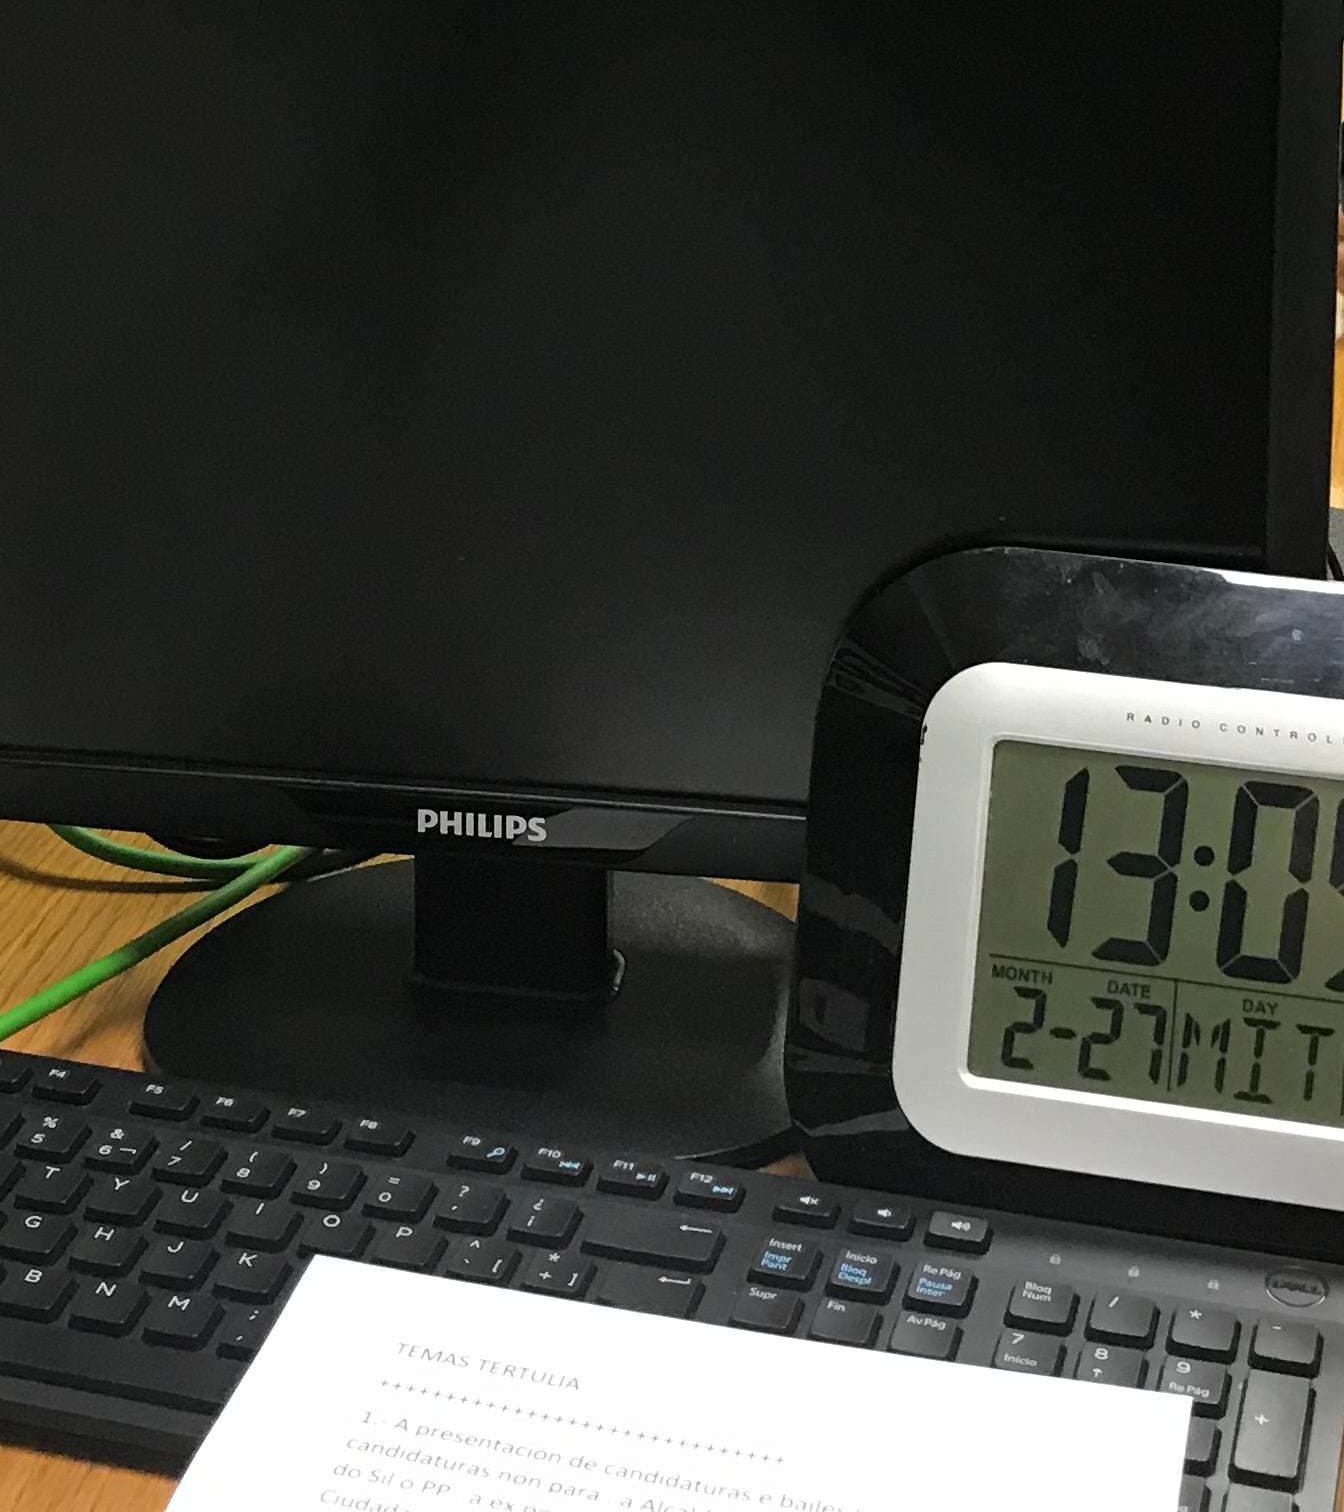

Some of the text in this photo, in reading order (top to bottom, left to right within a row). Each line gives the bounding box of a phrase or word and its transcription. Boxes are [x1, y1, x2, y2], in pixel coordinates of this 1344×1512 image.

[1126, 711, 1201, 730] RADIO
[417, 808, 548, 842] PHILIPS
[991, 963, 1054, 986] MONTH
[1107, 979, 1151, 1000] DATE
[1242, 998, 1279, 1016] DAY
[1176, 1012, 1336, 1105] MIT
[98, 1144, 112, 1156] 6
[167, 1155, 182, 1167] 7
[612, 1159, 635, 1171] F11
[44, 1165, 61, 1180] T
[236, 1167, 252, 1179] 8
[689, 1171, 714, 1184] F12
[113, 1177, 130, 1191] Y
[307, 1179, 322, 1191] 9
[181, 1189, 199, 1204] U
[24, 1215, 43, 1229] G
[94, 1226, 115, 1241] H
[395, 1226, 413, 1238] P
[167, 1240, 184, 1254] J
[768, 1237, 803, 1253] Insert
[238, 1252, 259, 1267] K
[24, 1268, 43, 1284] B
[95, 1281, 117, 1297] N
[918, 1277, 953, 1292] Pausa
[1024, 1280, 1053, 1295] Bloq
[749, 1287, 778, 1301] Supr
[1021, 1289, 1053, 1303] Num
[167, 1296, 191, 1311] M
[826, 1300, 846, 1313] Fin
[1011, 1332, 1026, 1345] 7
[1003, 1353, 1039, 1368] Inicio
[1094, 1347, 1109, 1361] 8
[397, 1341, 581, 1391] TEMAS TERTULIA
[1176, 1360, 1192, 1374] 9
[394, 1417, 409, 1432] A
[569, 1454, 598, 1472] de
[604, 1461, 752, 1503] candidaturas
[759, 1491, 773, 1506] e
[346, 1436, 491, 1479] candidaturas
[497, 1469, 542, 1489] non
[548, 1479, 600, 1503] para
[332, 1462, 362, 1479] do
[368, 1467, 394, 1487] Sil
[400, 1476, 414, 1491] o
[421, 1480, 452, 1497] PP
[468, 1493, 482, 1507] a
[489, 1495, 514, 1512] ex
